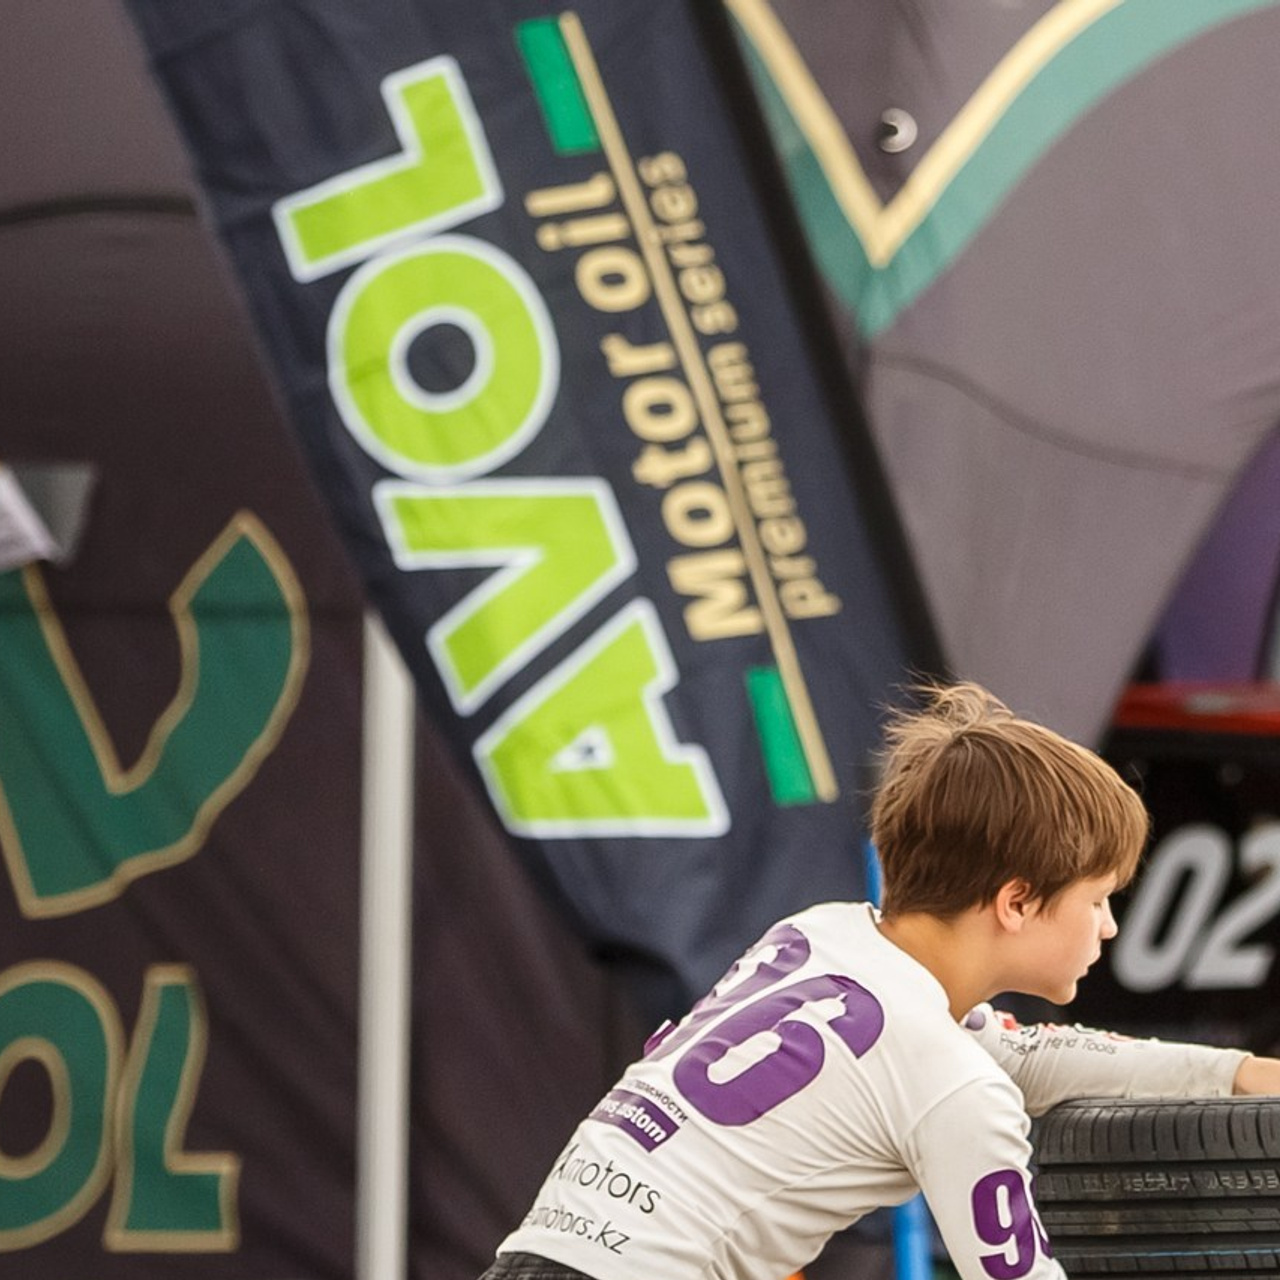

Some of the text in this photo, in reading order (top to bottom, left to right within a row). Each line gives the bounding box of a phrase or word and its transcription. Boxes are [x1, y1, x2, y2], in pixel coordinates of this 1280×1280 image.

[274, 55, 730, 839] AVOL
[524, 172, 766, 642] Motor oil
[640, 150, 842, 620] premium series
